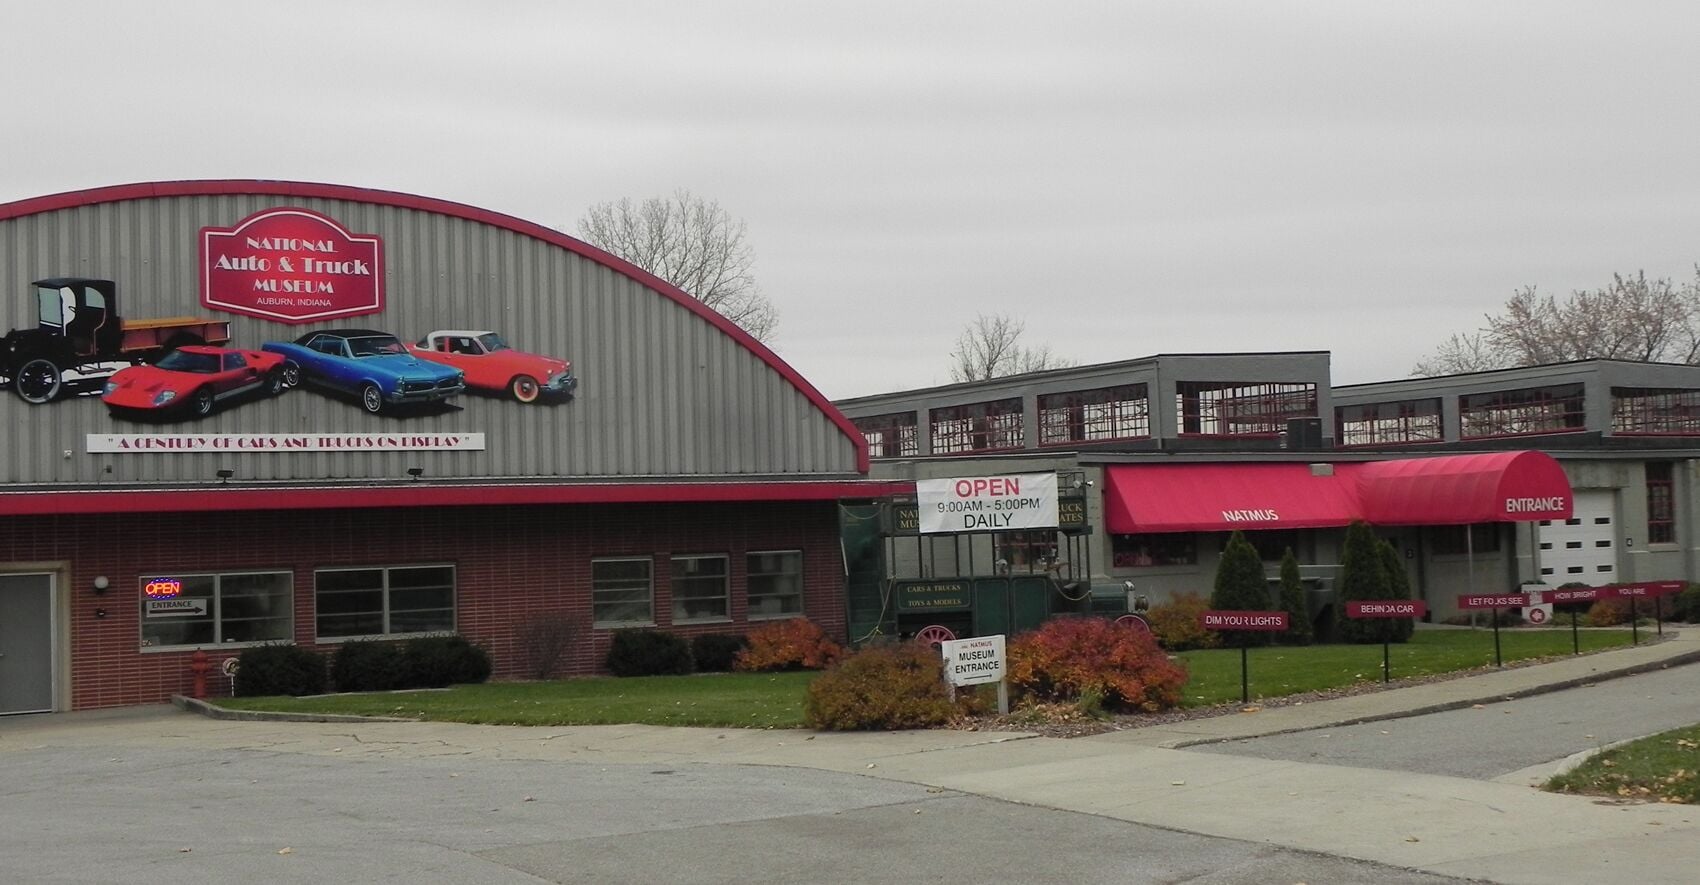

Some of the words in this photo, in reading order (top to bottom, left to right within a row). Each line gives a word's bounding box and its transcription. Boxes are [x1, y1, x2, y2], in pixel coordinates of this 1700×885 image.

[246, 237, 338, 252] NATIONAL
[214, 254, 271, 272] Auto
[279, 256, 294, 272] &
[301, 257, 370, 275] Truck
[253, 279, 334, 294] MUSEUM
[257, 298, 295, 306] AUBURN,
[298, 298, 332, 307] INDIANA
[134, 438, 206, 448] CENTURY
[213, 438, 232, 448] OF
[238, 438, 277, 448] CARS
[282, 438, 312, 448] AND
[318, 437, 373, 448] TRUCKS
[378, 437, 398, 447] ON
[402, 436, 460, 447] DISPLAY
[956, 478, 1020, 498] OPEN
[938, 500, 982, 513] 9:00AM
[994, 498, 1040, 510] 5:00PM
[1506, 496, 1564, 512] ENTRANCE
[964, 512, 1013, 528] DAILY
[1222, 510, 1279, 522] NATMUS
[146, 582, 180, 594] OPEN
[152, 601, 192, 609] ENTRANCE
[1469, 598, 1482, 606] LET
[1508, 596, 1523, 604] SEE
[1396, 604, 1414, 613] CAR
[1206, 616, 1222, 624] DIM
[1250, 616, 1282, 626] LIGHTS
[960, 650, 994, 660] MUSEUM
[956, 661, 999, 674] ENTRANCE
